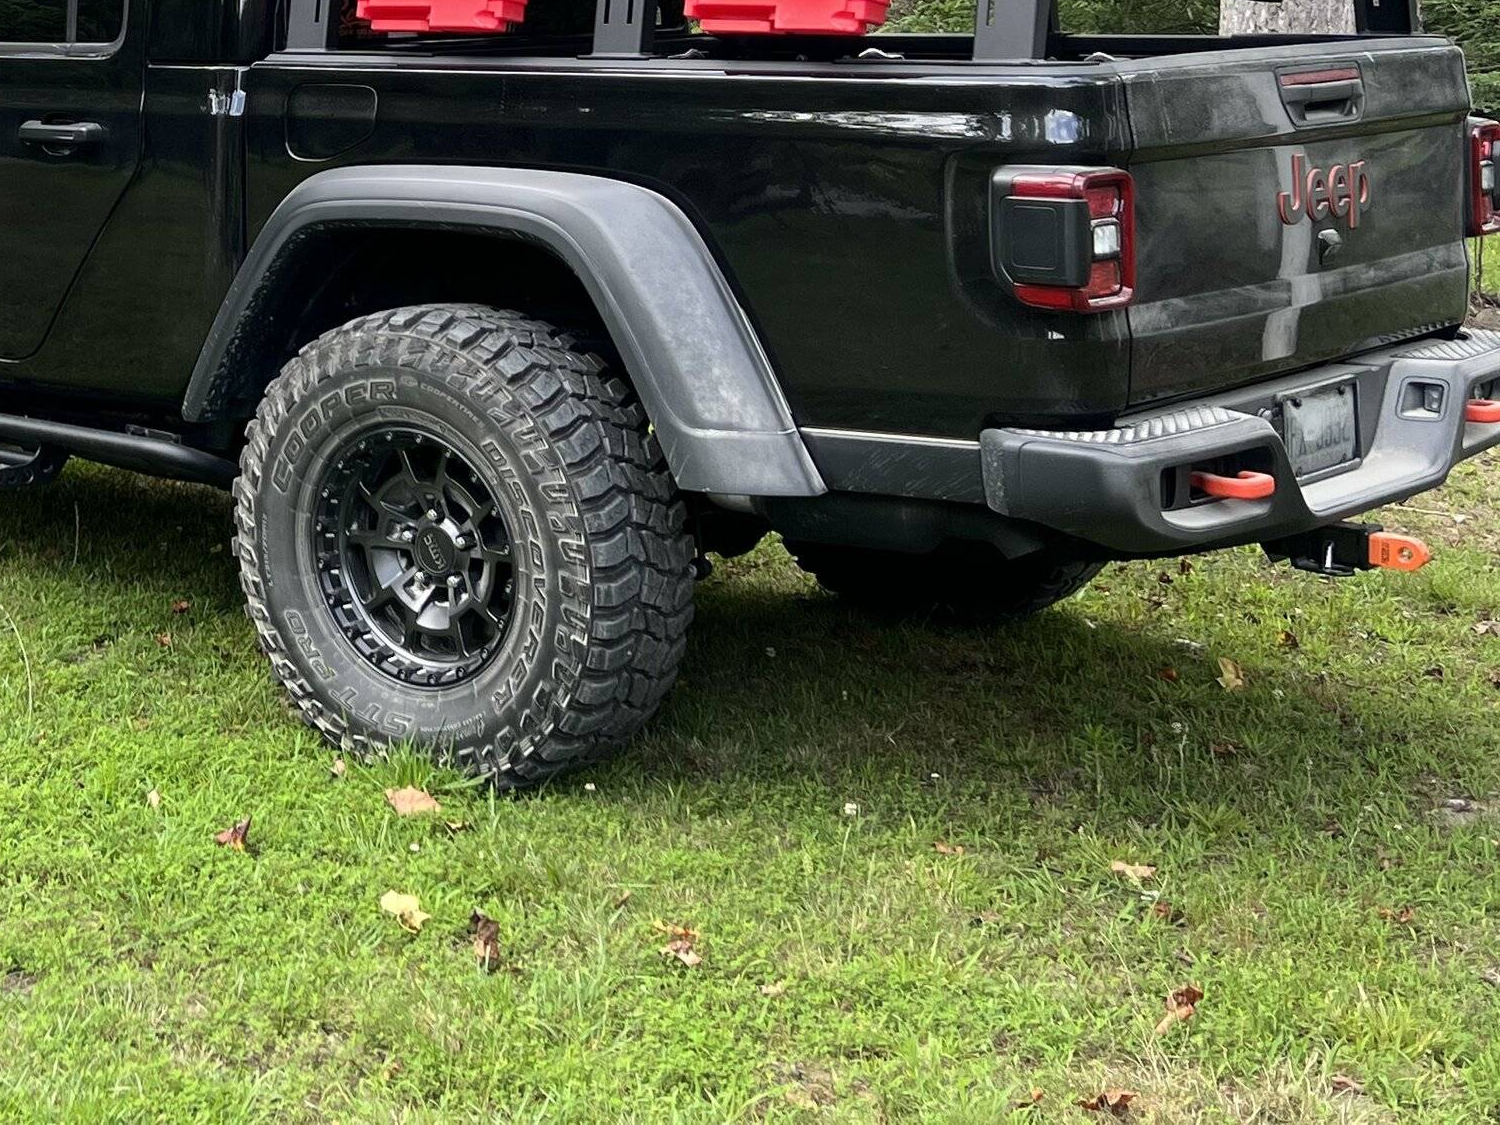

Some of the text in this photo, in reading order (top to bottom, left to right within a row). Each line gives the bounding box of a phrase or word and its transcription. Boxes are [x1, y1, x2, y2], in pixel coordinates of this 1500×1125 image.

[1276, 154, 1371, 230] Jeep
[272, 378, 397, 494] COOPER
[481, 439, 546, 715] DISCOVERER
[283, 610, 414, 736] STT PRO
